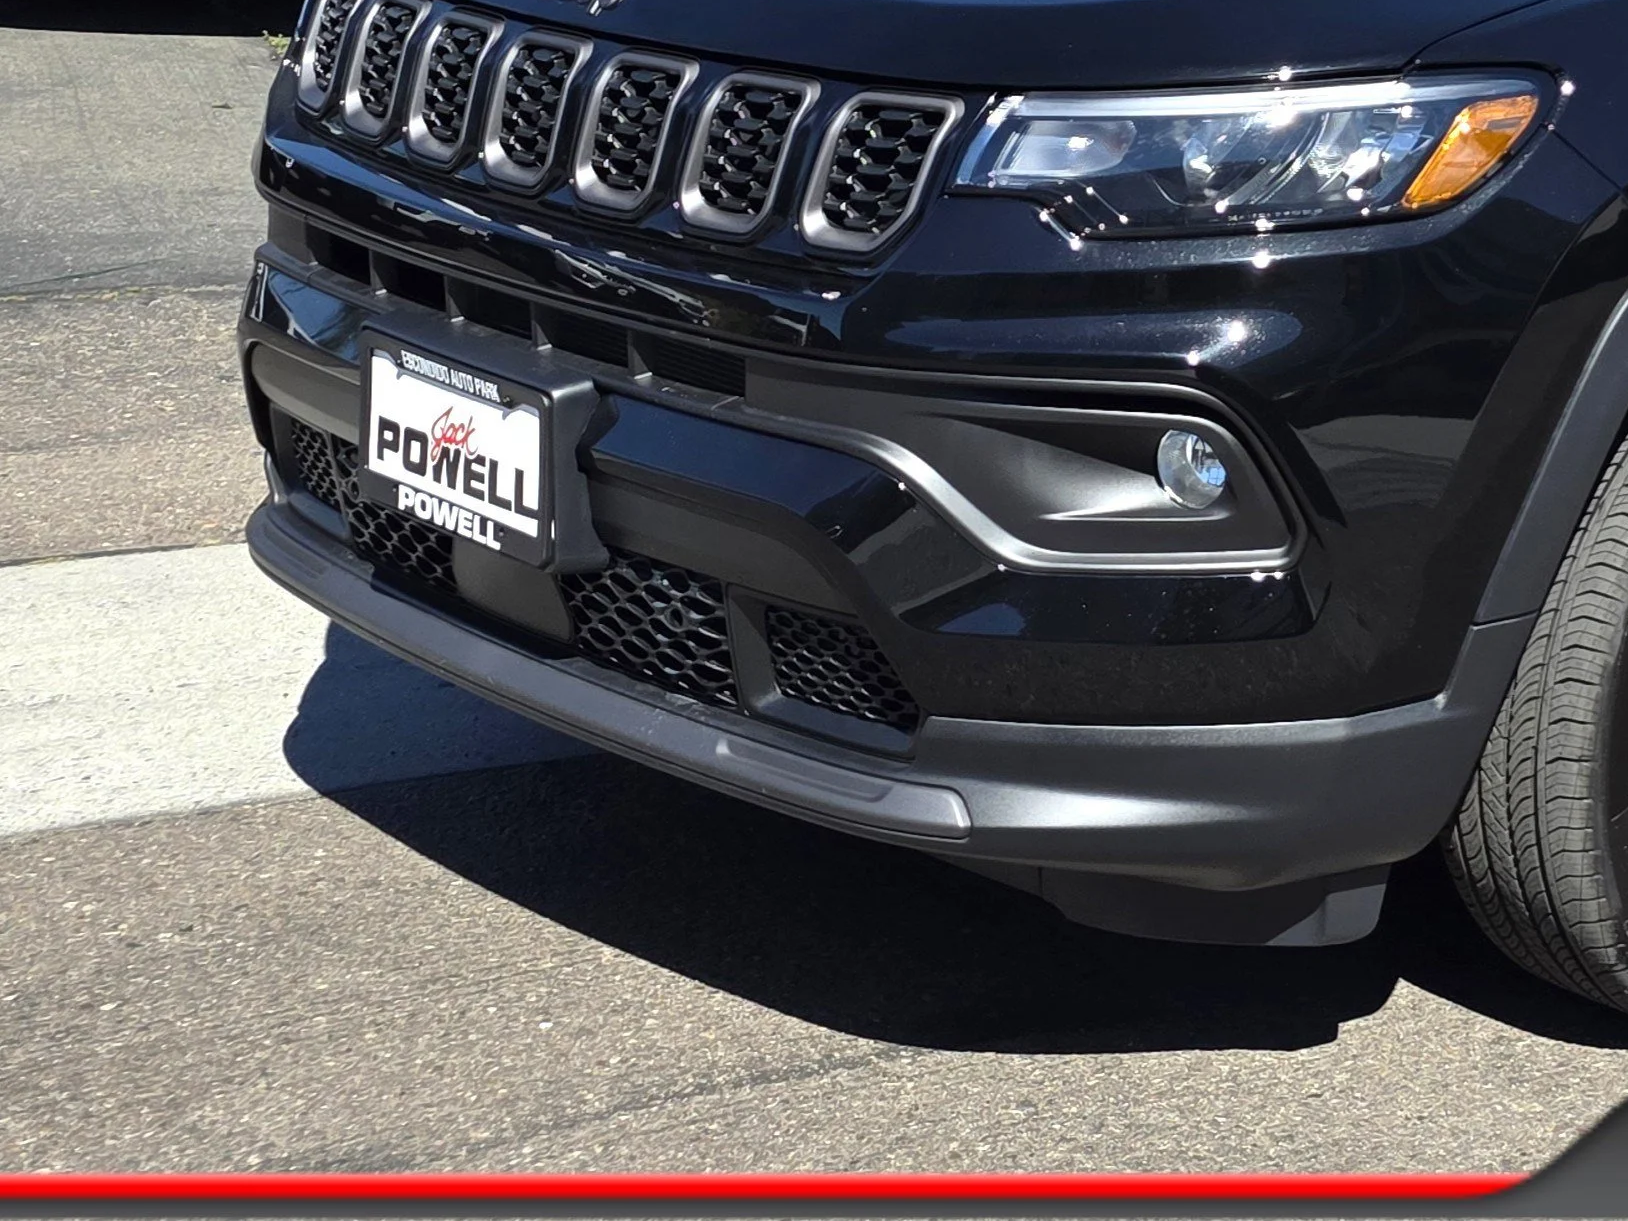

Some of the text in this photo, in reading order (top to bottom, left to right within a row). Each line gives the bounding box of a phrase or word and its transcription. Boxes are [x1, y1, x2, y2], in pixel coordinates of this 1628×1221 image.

[400, 349, 501, 403] ESCONDIDO AUTO PARK
[430, 405, 479, 462] Jack
[376, 415, 539, 522] POWELL
[397, 483, 501, 551] POWELL
